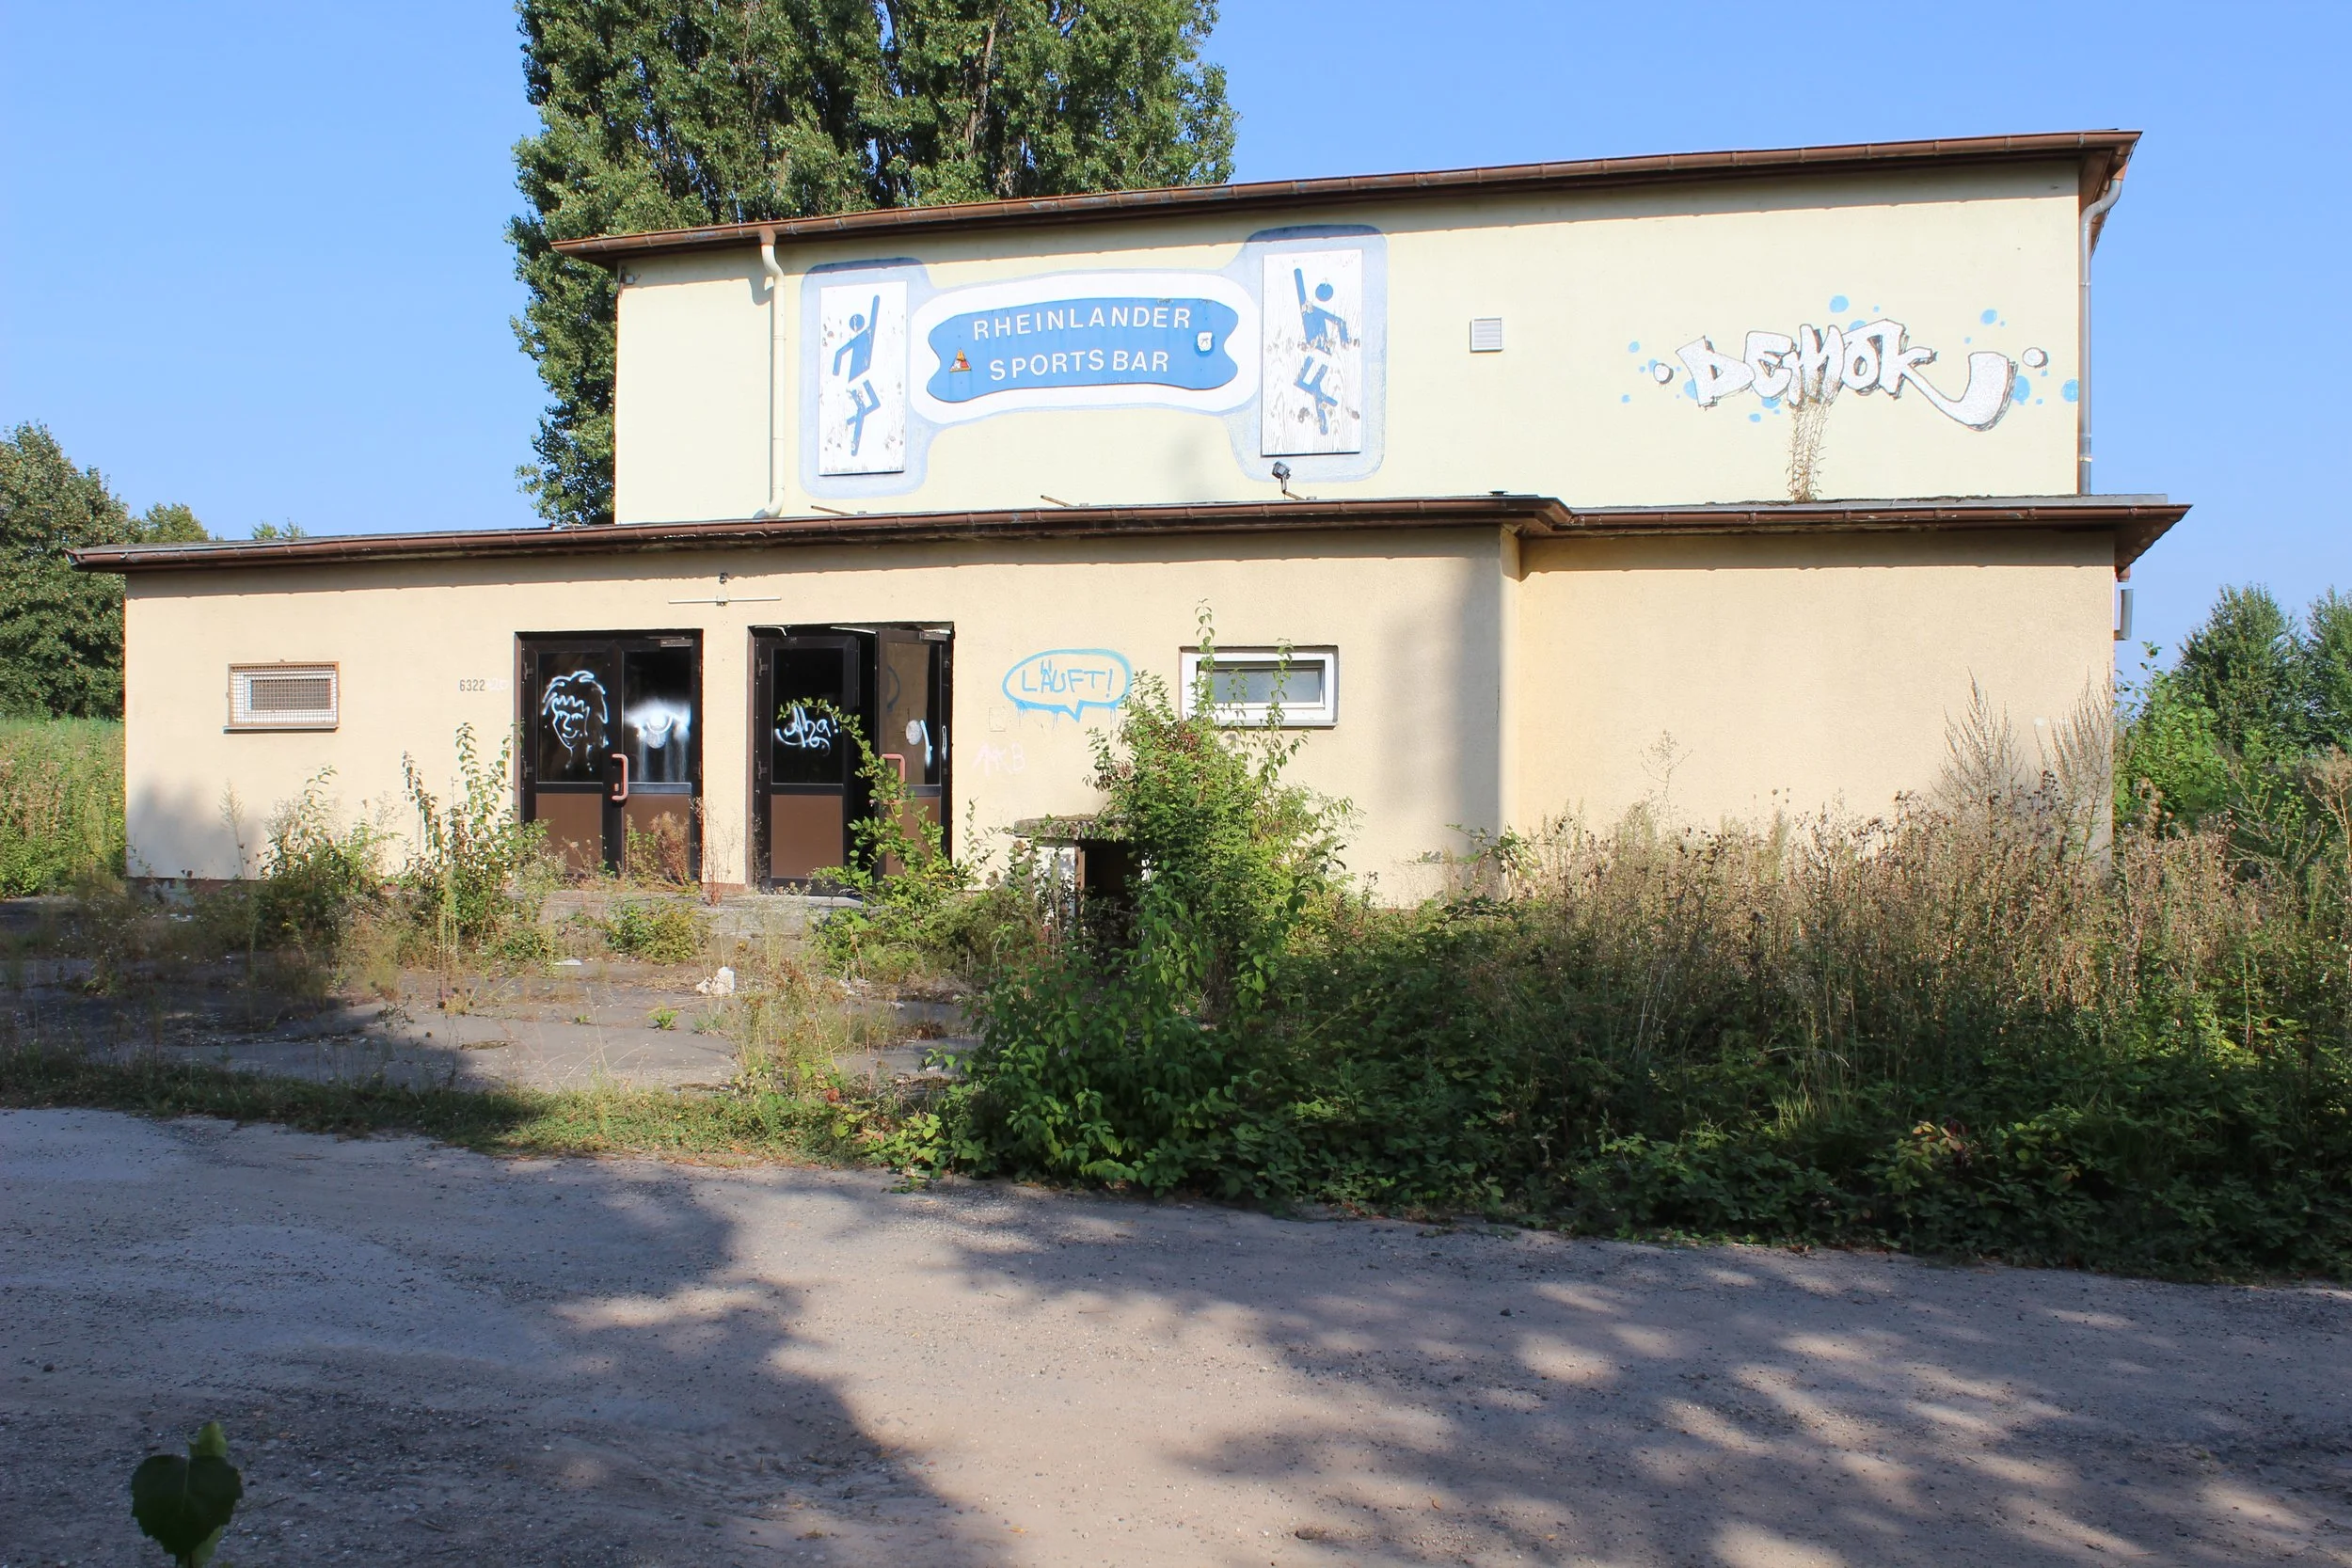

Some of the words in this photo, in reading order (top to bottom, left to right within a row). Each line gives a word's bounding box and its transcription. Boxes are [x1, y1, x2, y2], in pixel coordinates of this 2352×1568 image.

[973, 307, 1192, 341] RHEINLANDER
[991, 349, 1104, 382] SPORTS
[1111, 351, 1169, 372] BAR
[459, 678, 485, 691] 6322
[1022, 660, 1114, 699] LÄUFT!
